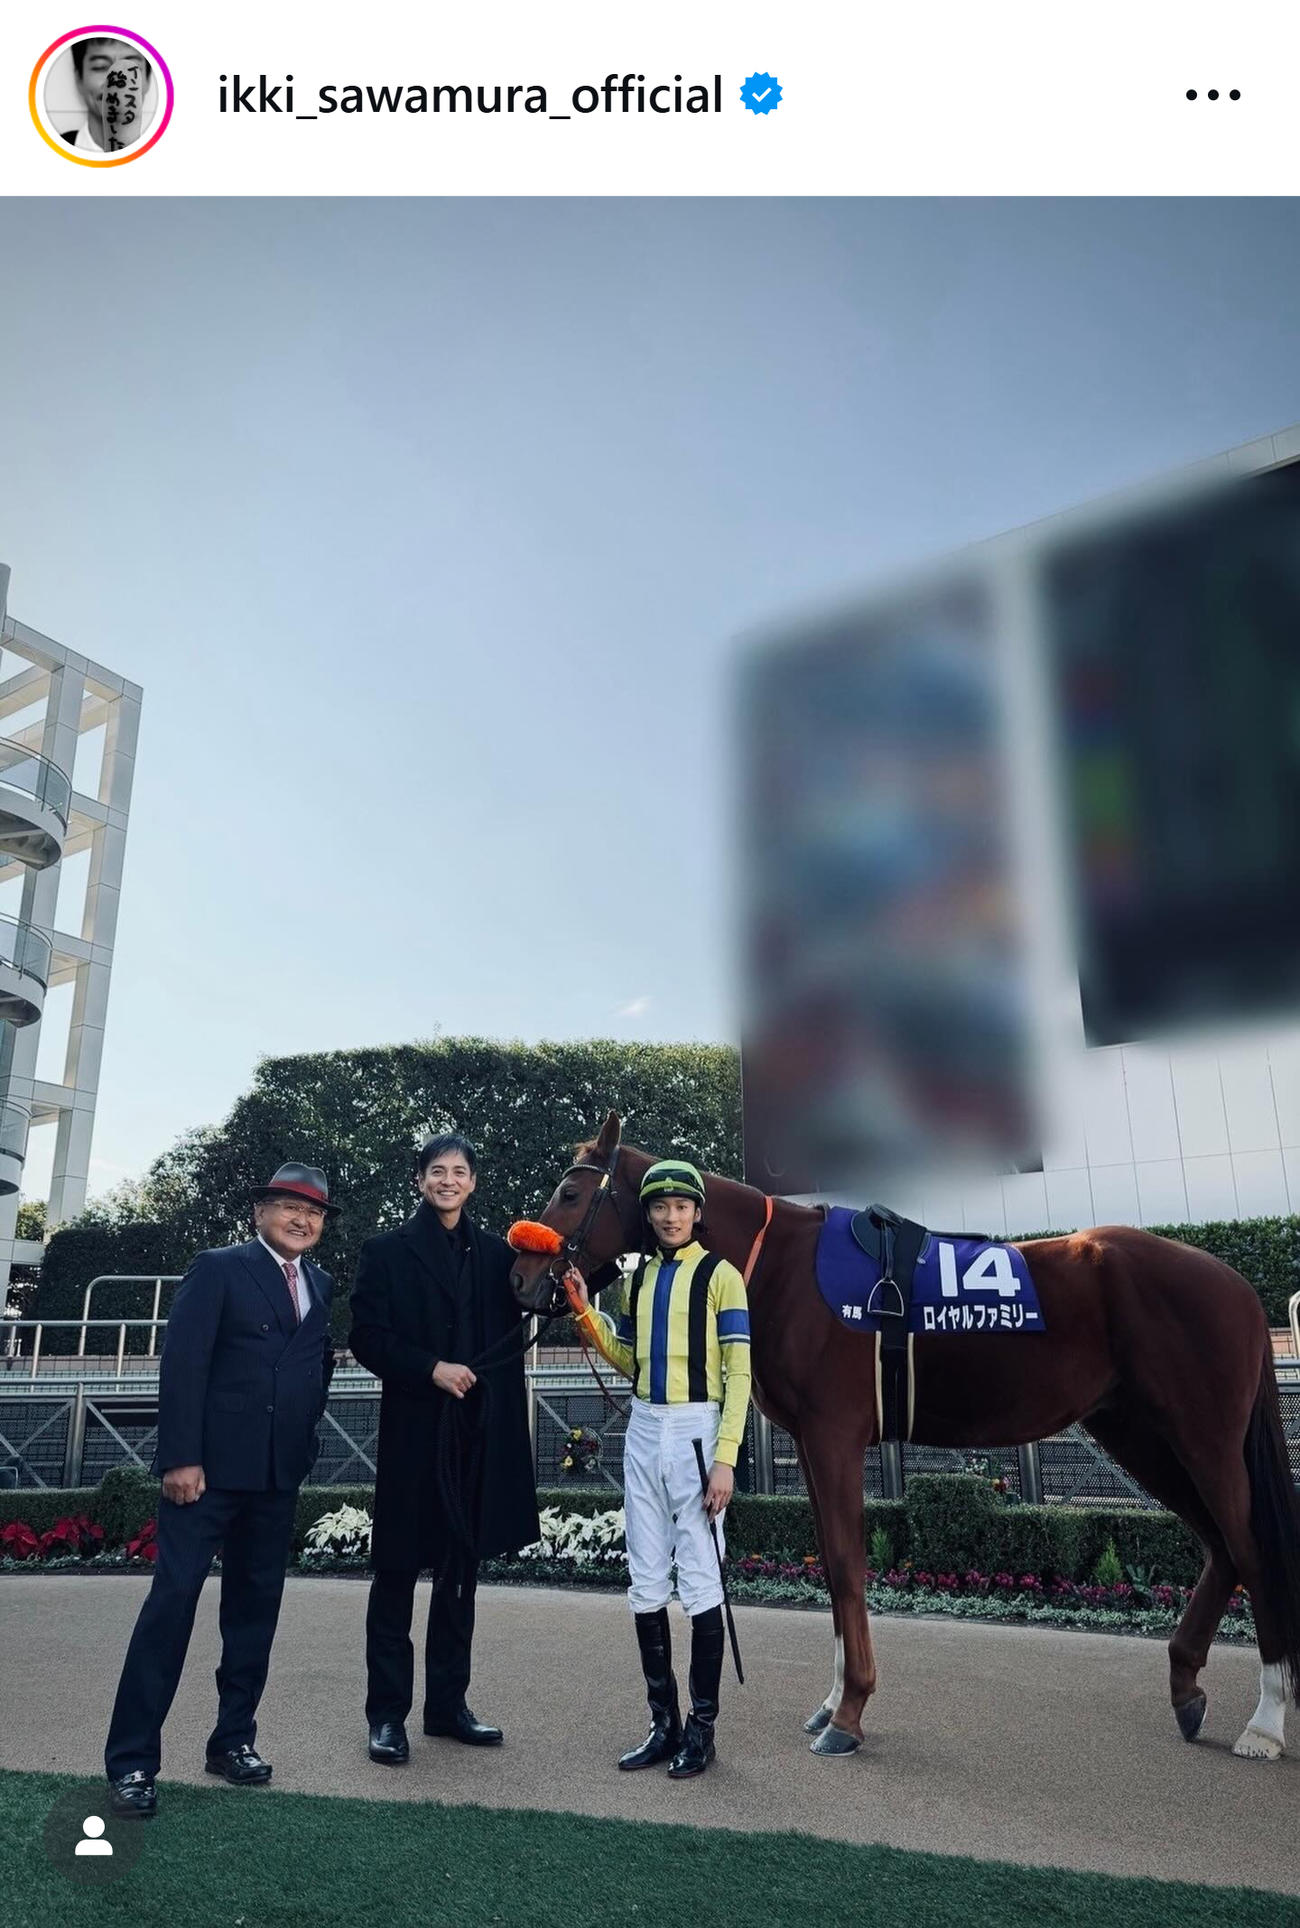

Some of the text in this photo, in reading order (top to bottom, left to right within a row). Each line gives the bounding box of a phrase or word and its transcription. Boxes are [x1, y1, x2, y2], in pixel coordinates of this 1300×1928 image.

[121, 66, 139, 125] インスタ
[938, 1242, 1021, 1297] 14
[842, 1304, 863, 1320] 有馬
[923, 1303, 1038, 1331] ロイヤルファミリー
